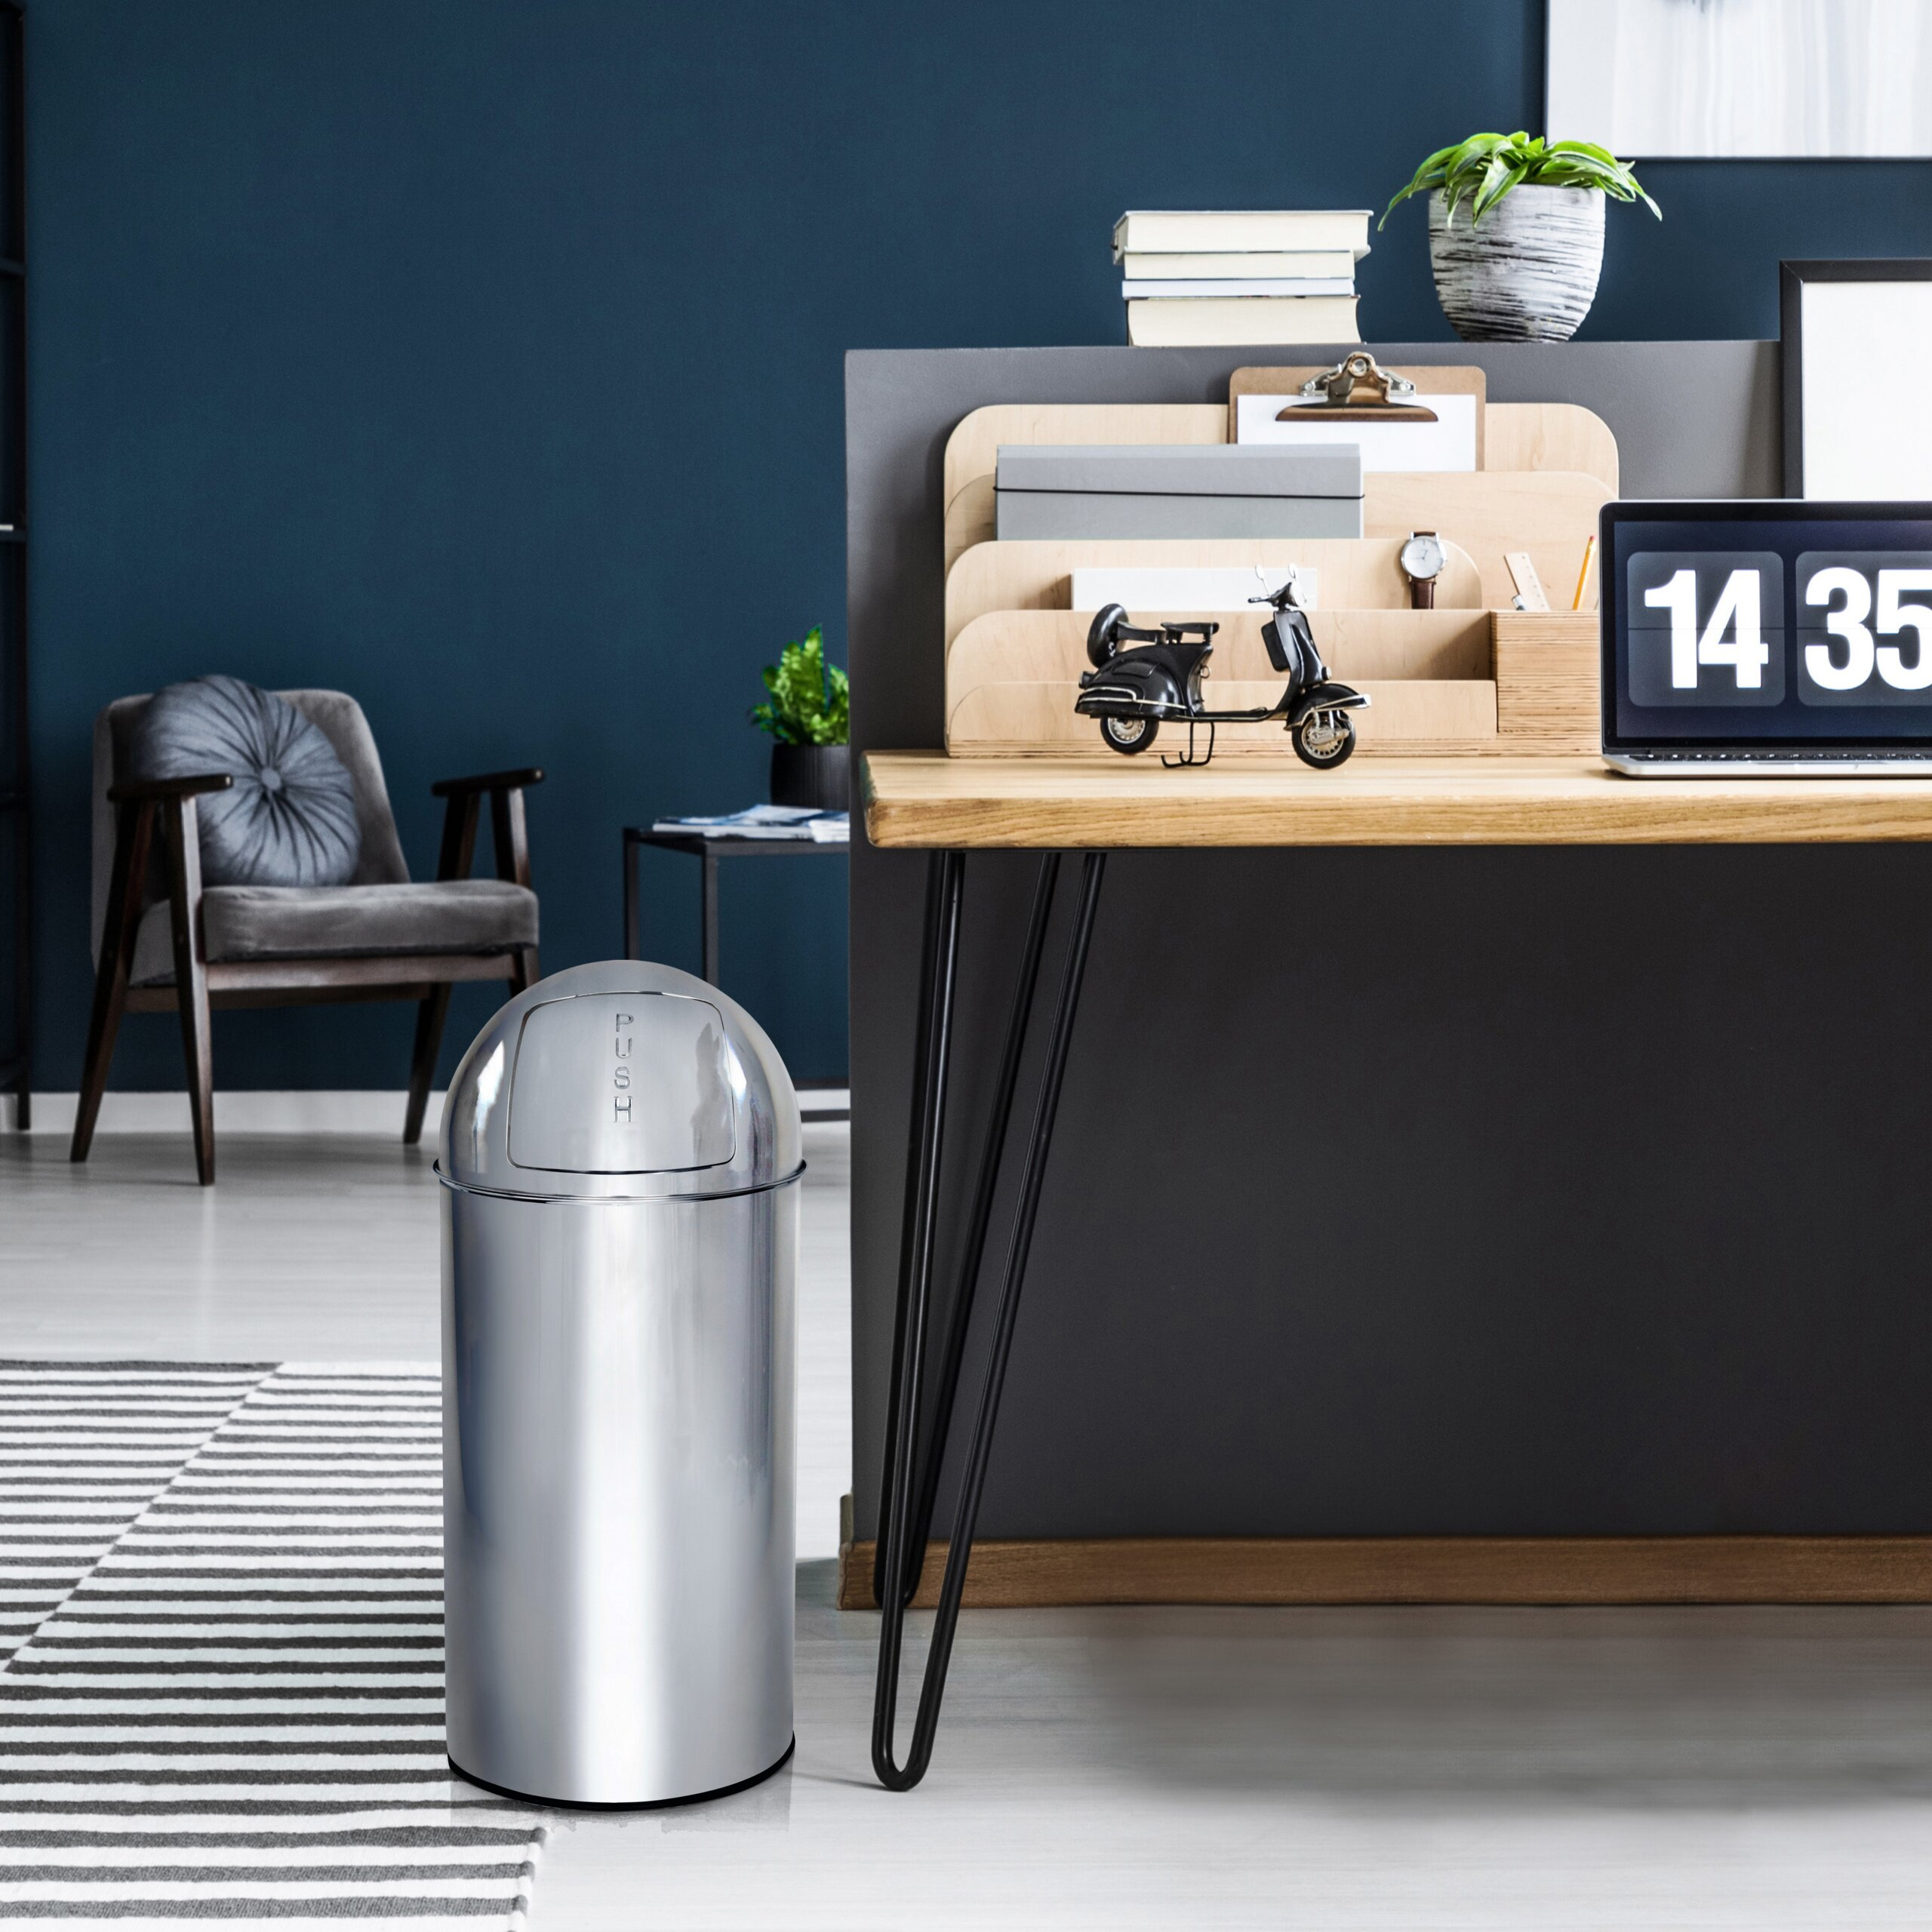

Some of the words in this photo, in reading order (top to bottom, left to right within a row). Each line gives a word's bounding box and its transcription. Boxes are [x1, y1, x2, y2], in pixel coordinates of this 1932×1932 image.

[1644, 568, 1769, 689] 14
[1804, 567, 1932, 691] 35
[613, 1013, 634, 1123] PUSH
